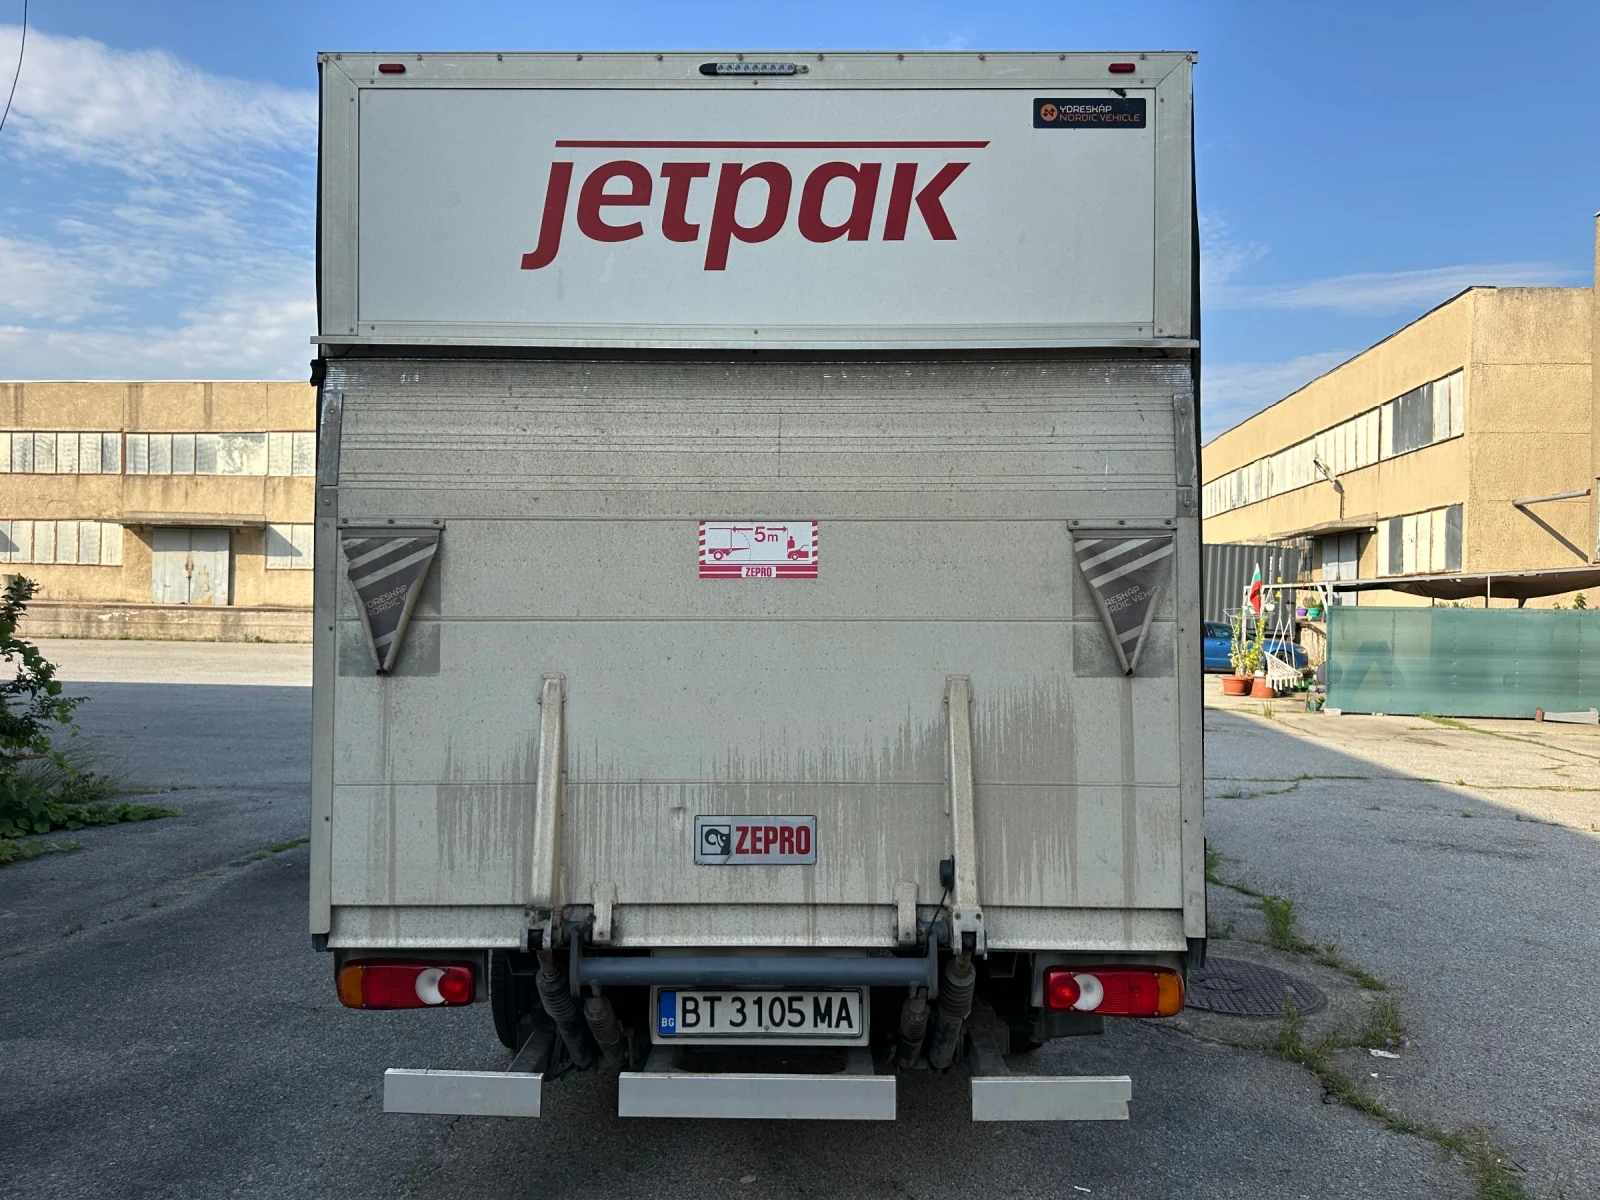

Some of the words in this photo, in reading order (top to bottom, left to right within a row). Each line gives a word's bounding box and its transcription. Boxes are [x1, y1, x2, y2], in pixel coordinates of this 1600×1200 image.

[1059, 113, 1097, 122] NORDIC
[1100, 113, 1140, 122] VEHICLE
[520, 160, 971, 271] jetpak
[745, 566, 772, 577] ZEPRO
[365, 584, 408, 609] DRESKÅP
[1109, 598, 1132, 614] RDIC
[735, 825, 811, 855] ZEPRO
[661, 1017, 675, 1028] BG
